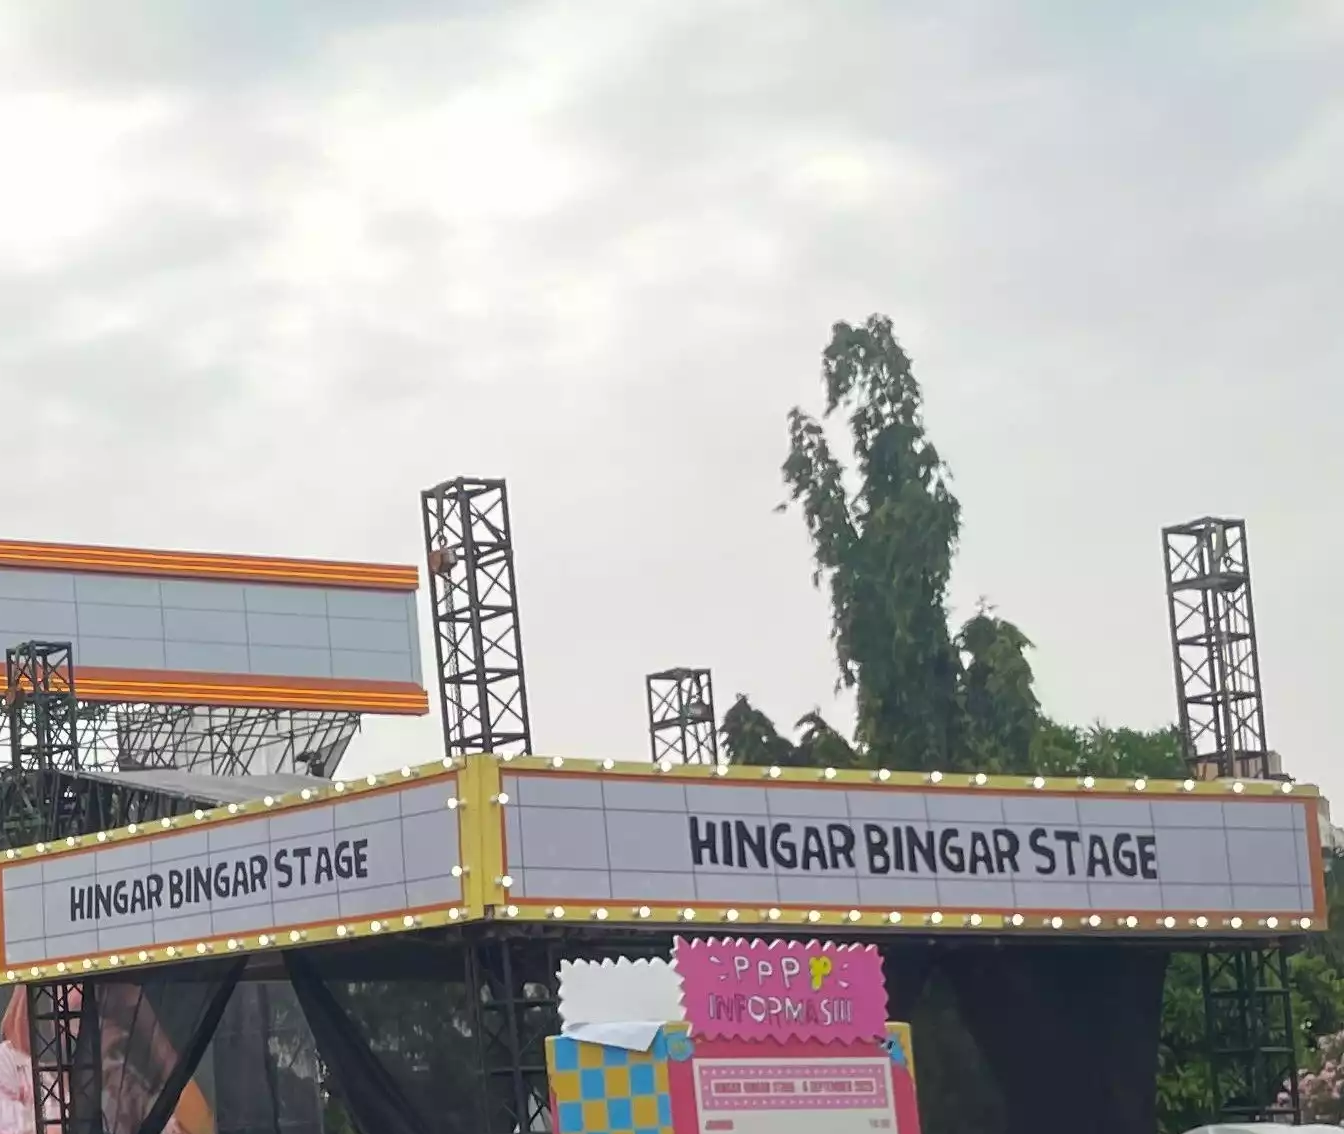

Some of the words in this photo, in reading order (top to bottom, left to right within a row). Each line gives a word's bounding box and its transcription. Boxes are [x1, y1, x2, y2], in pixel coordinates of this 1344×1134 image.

[70, 873, 163, 922] HINGAR
[168, 854, 269, 910] BINGAR
[274, 838, 369, 889] STAGE
[688, 815, 856, 870] HINGAR
[863, 823, 1021, 876] BINGAR
[1028, 827, 1158, 880] STAGE
